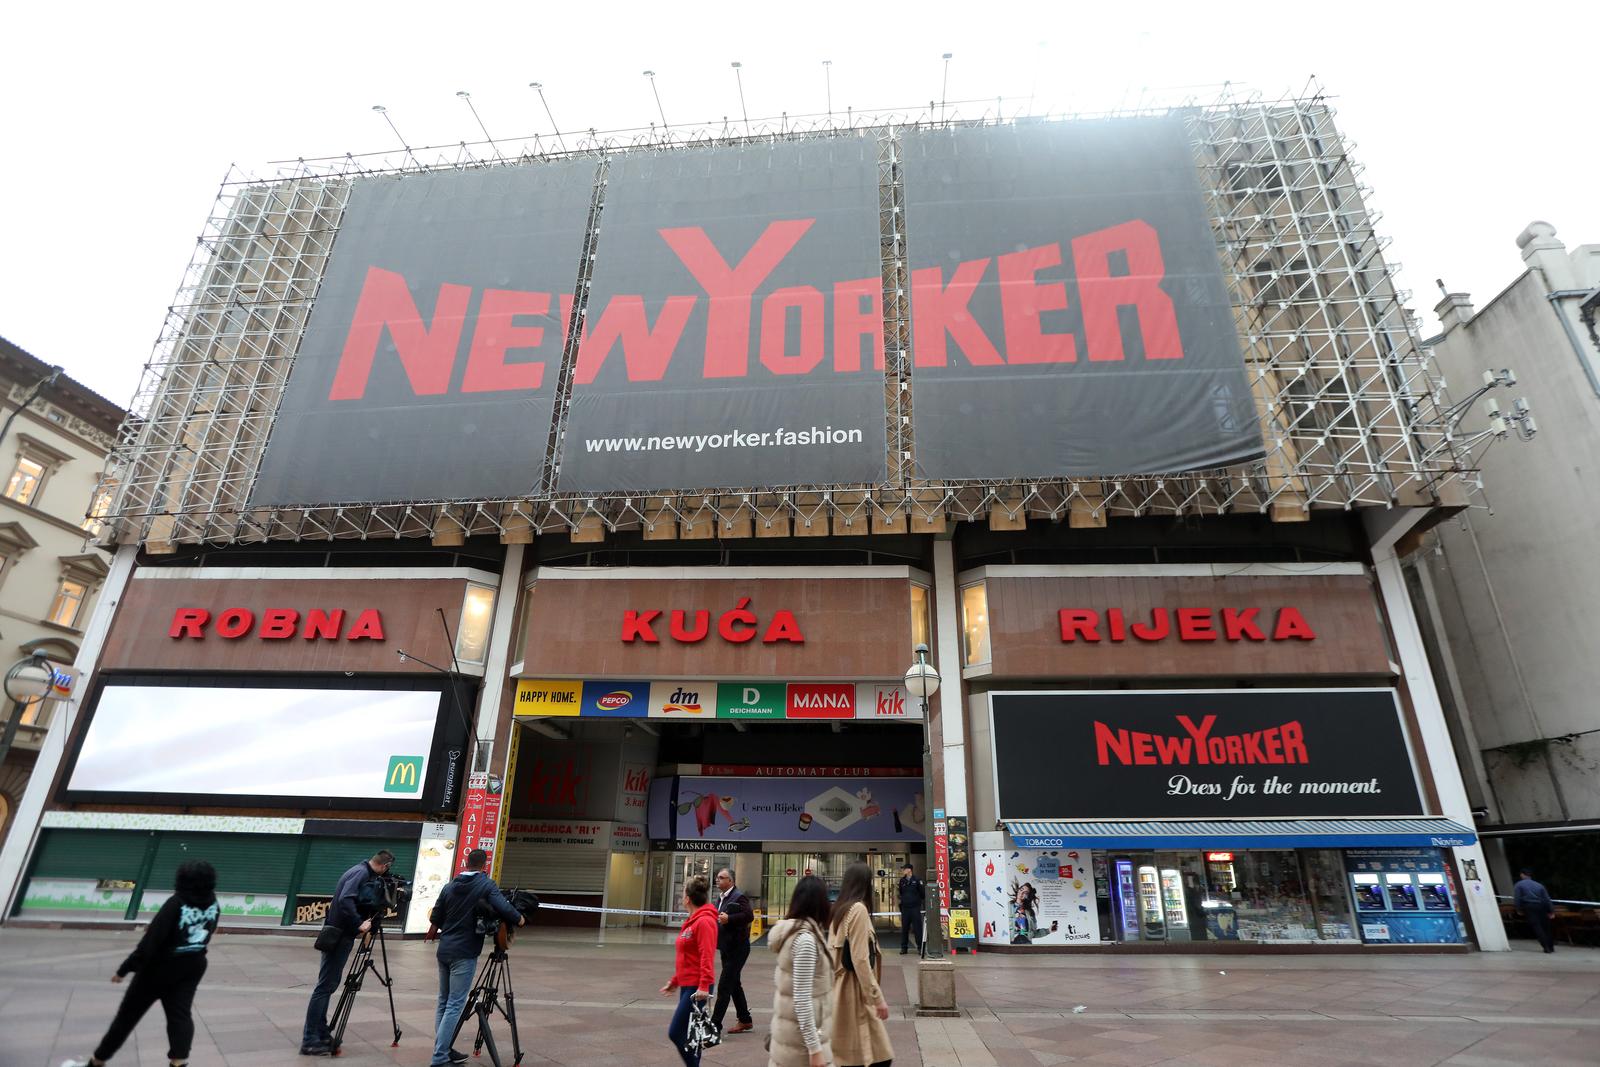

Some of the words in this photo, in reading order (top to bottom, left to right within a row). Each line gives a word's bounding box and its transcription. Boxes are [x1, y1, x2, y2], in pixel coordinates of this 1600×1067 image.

[585, 426, 863, 452] www.newyorker.fashion
[168, 607, 386, 642] ROBNA
[621, 597, 805, 644] KUĆA
[1058, 607, 1316, 643] RIJEKA
[520, 691, 548, 703] HAPPY
[550, 691, 577, 704] HOME.
[601, 696, 627, 705] PEPCO
[669, 687, 699, 704] dm
[742, 687, 761, 706] D
[793, 692, 851, 709] MANA
[876, 688, 905, 715] kik
[1094, 715, 1310, 765] NEWYORKER
[624, 767, 649, 793] kik
[755, 767, 827, 776] AUTOMAT
[834, 767, 871, 776] CLUB
[445, 762, 456, 804] europlakat
[1167, 774, 1222, 796] Dress
[1222, 775, 1256, 800] for
[1263, 776, 1293, 795] the
[1299, 778, 1382, 794] moment.
[742, 803, 750, 812] U
[774, 802, 804, 815] Rijeke
[676, 842, 715, 851] MASKICE
[1025, 838, 1063, 846] TOBACCO
[983, 920, 997, 938] A1
